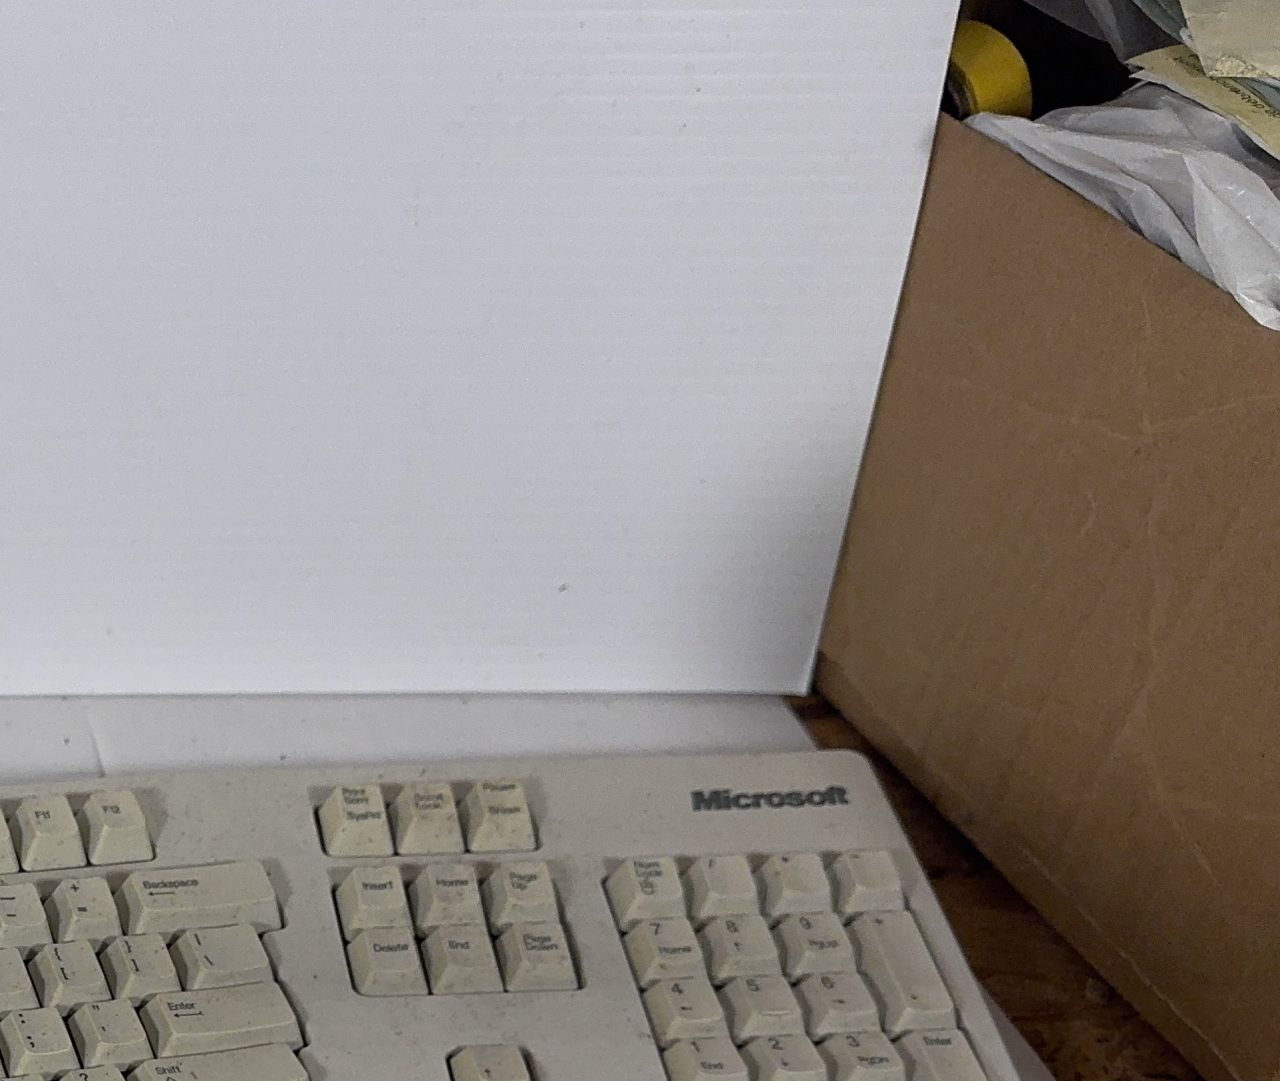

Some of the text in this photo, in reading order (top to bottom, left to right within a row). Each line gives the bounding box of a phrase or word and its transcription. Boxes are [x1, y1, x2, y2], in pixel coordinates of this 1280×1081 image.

[691, 785, 848, 812] Microsoft
[103, 804, 121, 815] F12
[142, 878, 199, 891] Backspace
[649, 922, 661, 936] 7
[799, 916, 812, 930] 9
[670, 982, 683, 994] 4
[745, 978, 760, 993] 5
[166, 1000, 197, 1011] Enter
[767, 1037, 785, 1051] 2
[845, 1035, 861, 1048] 3
[154, 1064, 182, 1077] Shift
